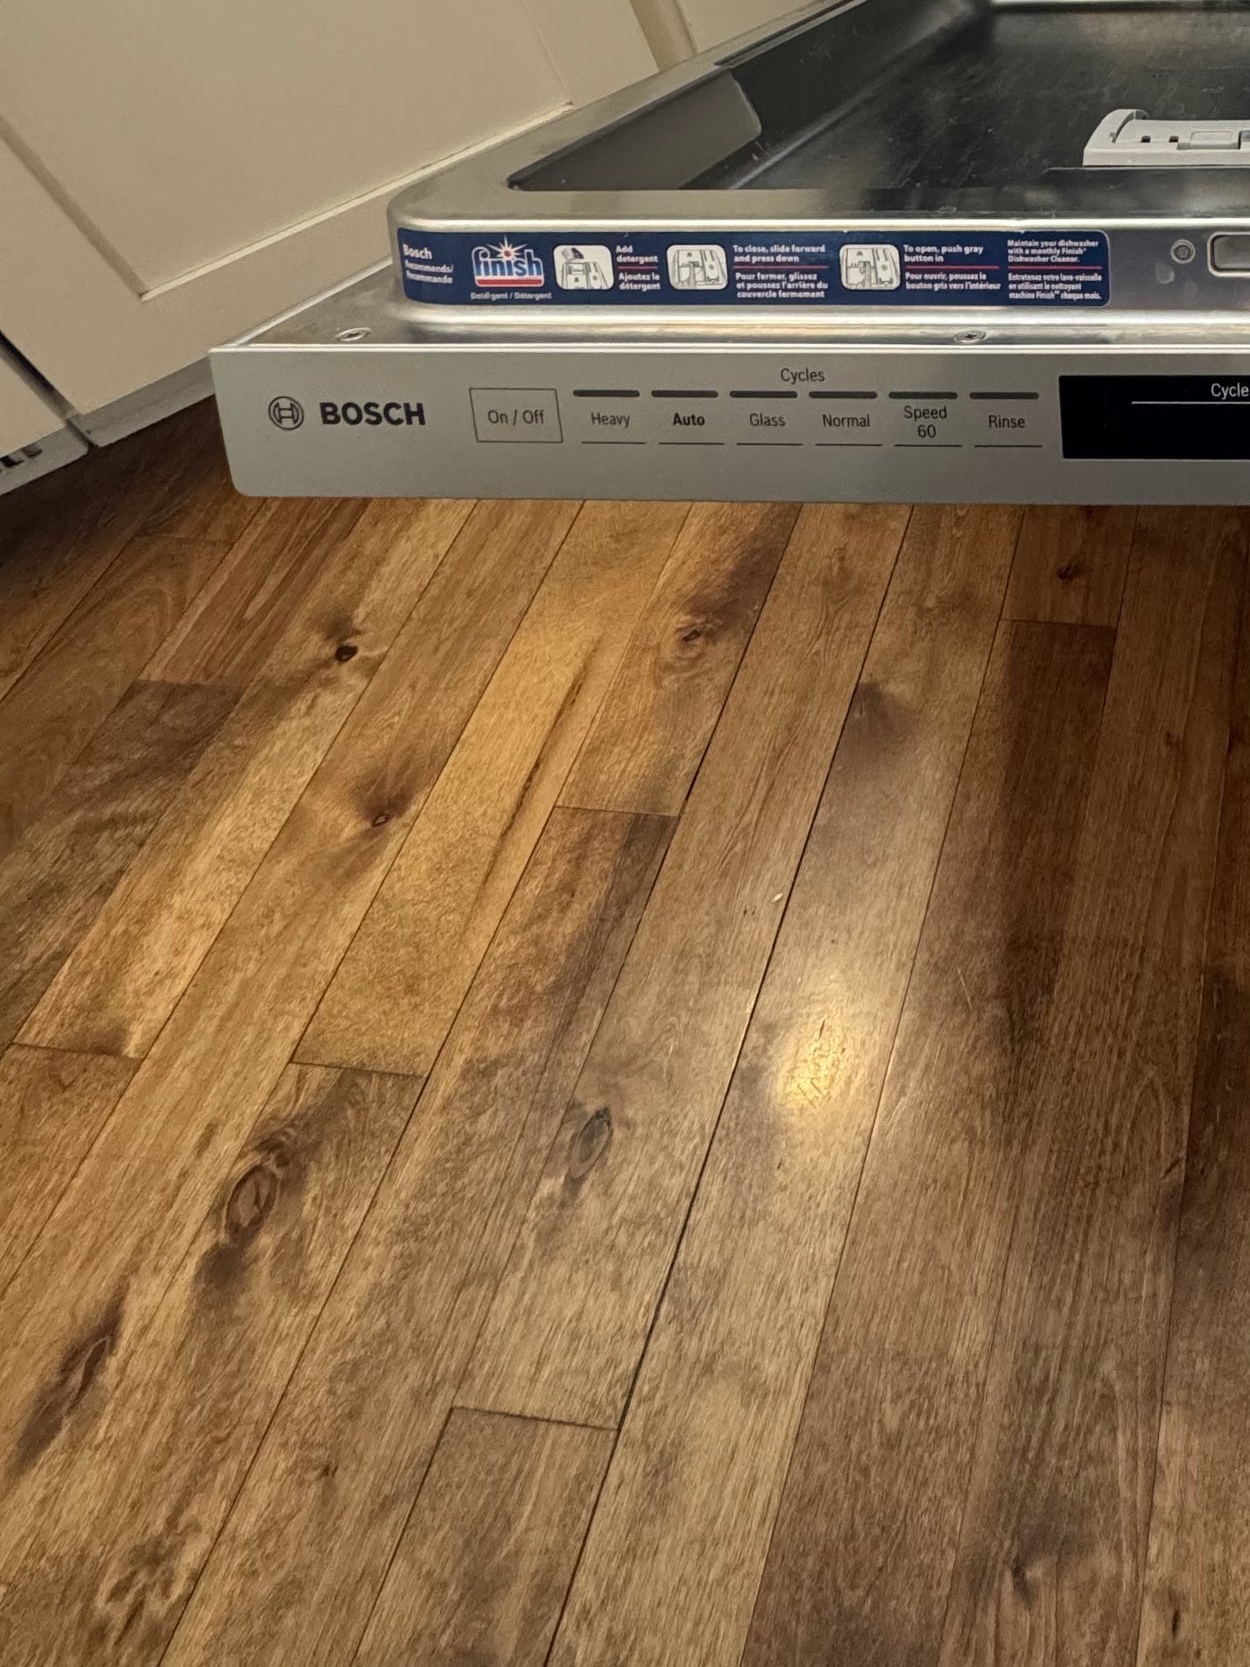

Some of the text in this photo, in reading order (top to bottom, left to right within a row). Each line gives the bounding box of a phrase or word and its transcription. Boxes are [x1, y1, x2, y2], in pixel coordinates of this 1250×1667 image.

[616, 245, 633, 254] Add
[733, 244, 826, 253] To close, slide forward
[903, 244, 984, 255] To open, push gray
[1007, 239, 1099, 248] Maintain your dishwasher
[403, 243, 432, 260] Bosch
[1007, 247, 1024, 255] with
[1030, 247, 1060, 256] monthly
[472, 245, 544, 280] finish
[617, 254, 659, 264] detergent
[734, 254, 800, 264] and press down
[904, 254, 944, 262] button in
[1007, 255, 1049, 263] Dishwasher
[735, 272, 755, 280] Pour
[788, 272, 817, 282] glissez
[905, 272, 922, 280] Pour
[747, 282, 780, 290] poussez
[816, 281, 828, 289] du
[737, 290, 825, 298] couvercle fermement
[780, 367, 826, 385] Cycles
[1210, 382, 1250, 400] Cycle
[319, 402, 427, 426] BOSCH
[487, 409, 509, 425] On
[522, 409, 545, 425] Off
[903, 405, 948, 422] Speed
[591, 412, 631, 429] Heavy
[672, 413, 706, 427] Auto
[748, 413, 787, 428] Glass
[822, 414, 871, 428] Normal
[988, 414, 1026, 429] Rinse
[916, 424, 937, 439] 60
